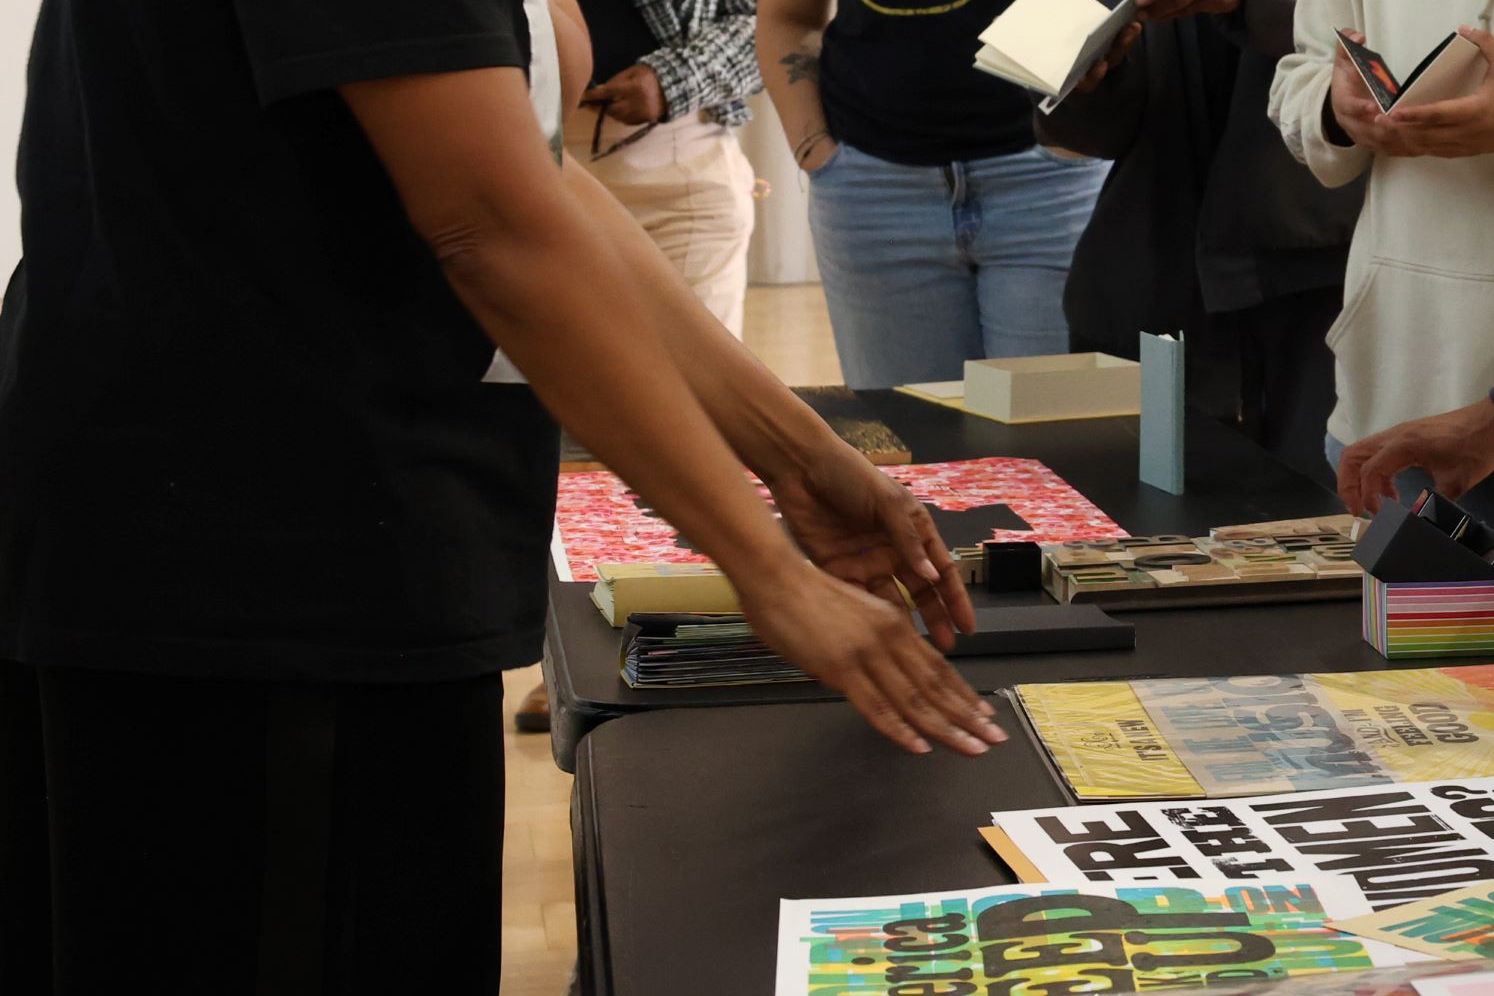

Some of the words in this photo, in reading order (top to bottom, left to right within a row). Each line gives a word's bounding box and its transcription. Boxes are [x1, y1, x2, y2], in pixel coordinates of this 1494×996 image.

[1372, 705, 1435, 746] FEELING
[1408, 703, 1480, 743] GOOD
[1161, 806, 1296, 880] THE
